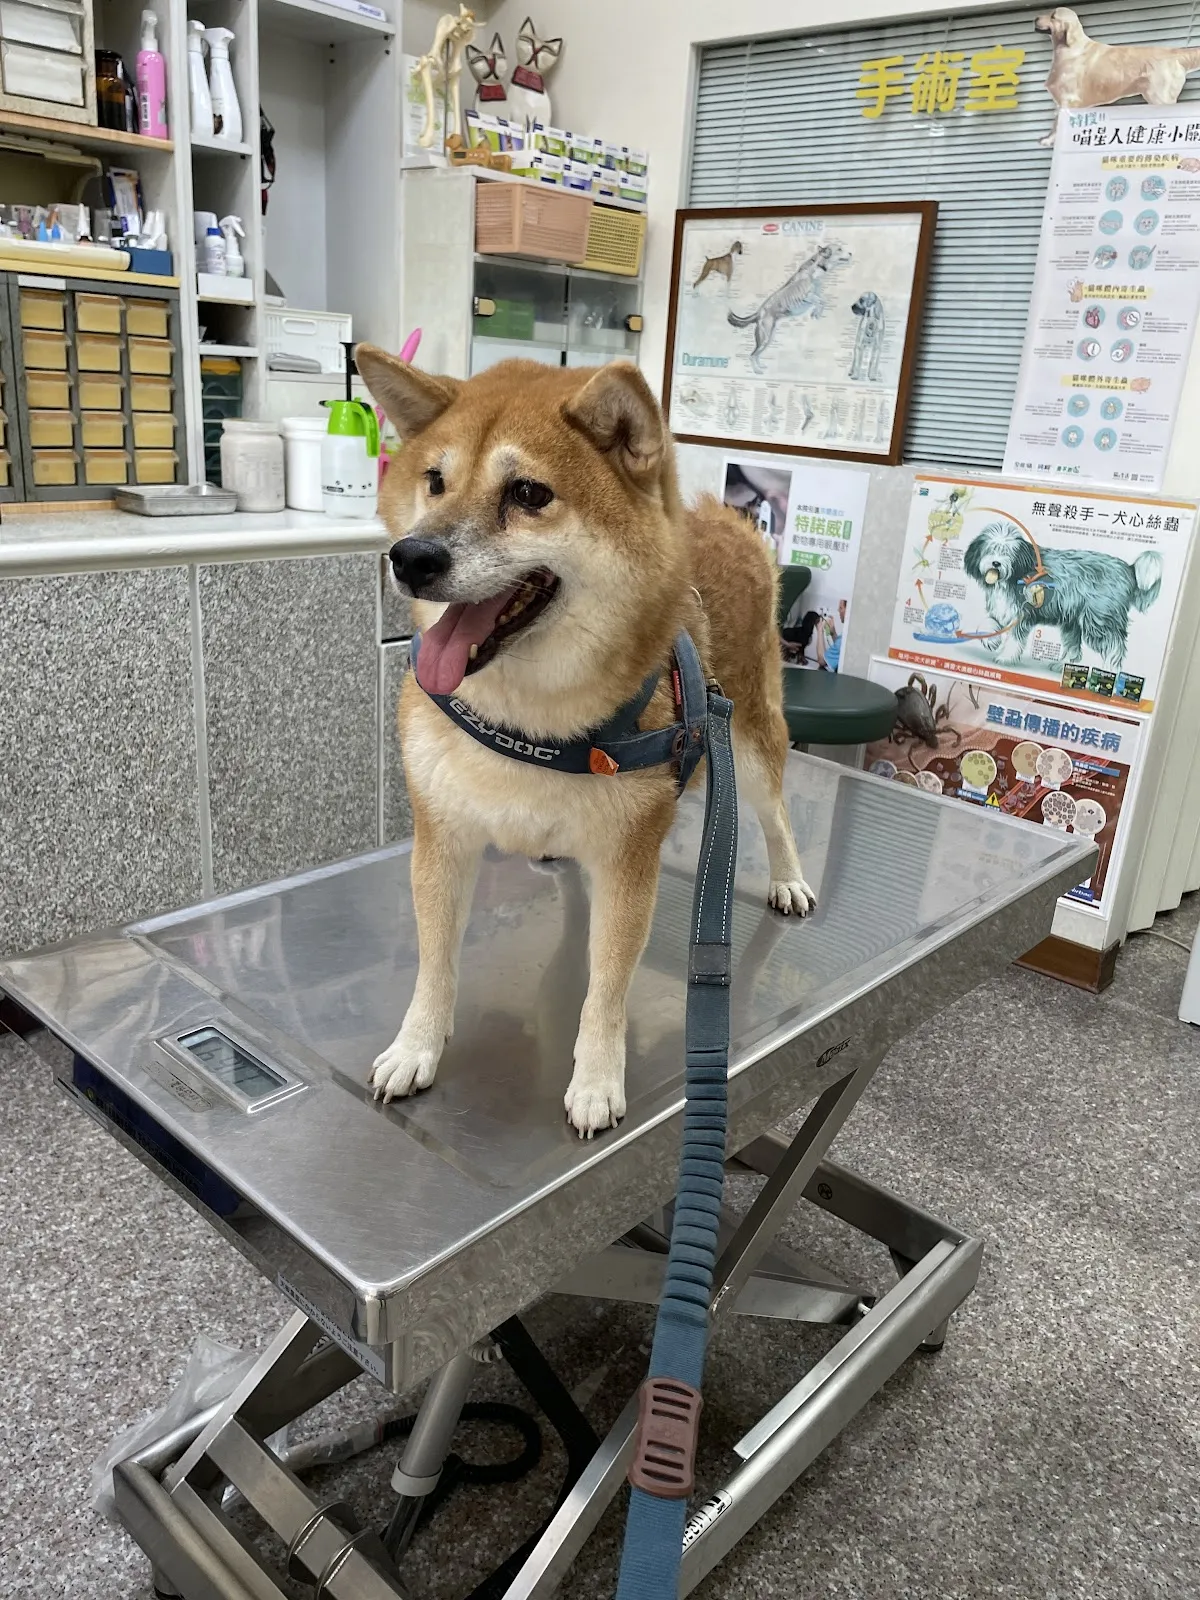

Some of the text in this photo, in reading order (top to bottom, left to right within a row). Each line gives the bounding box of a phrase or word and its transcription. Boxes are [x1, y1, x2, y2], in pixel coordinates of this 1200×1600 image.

[856, 45, 1025, 118] 手術室
[782, 220, 824, 232] CANINE
[794, 514, 842, 539] 特諾威
[791, 534, 849, 553] 動物專用眼壓計
[1035, 629, 1042, 639] 3
[449, 698, 555, 761] EZYDOG
[986, 704, 1122, 753] 壁蝨傳播的疾病
